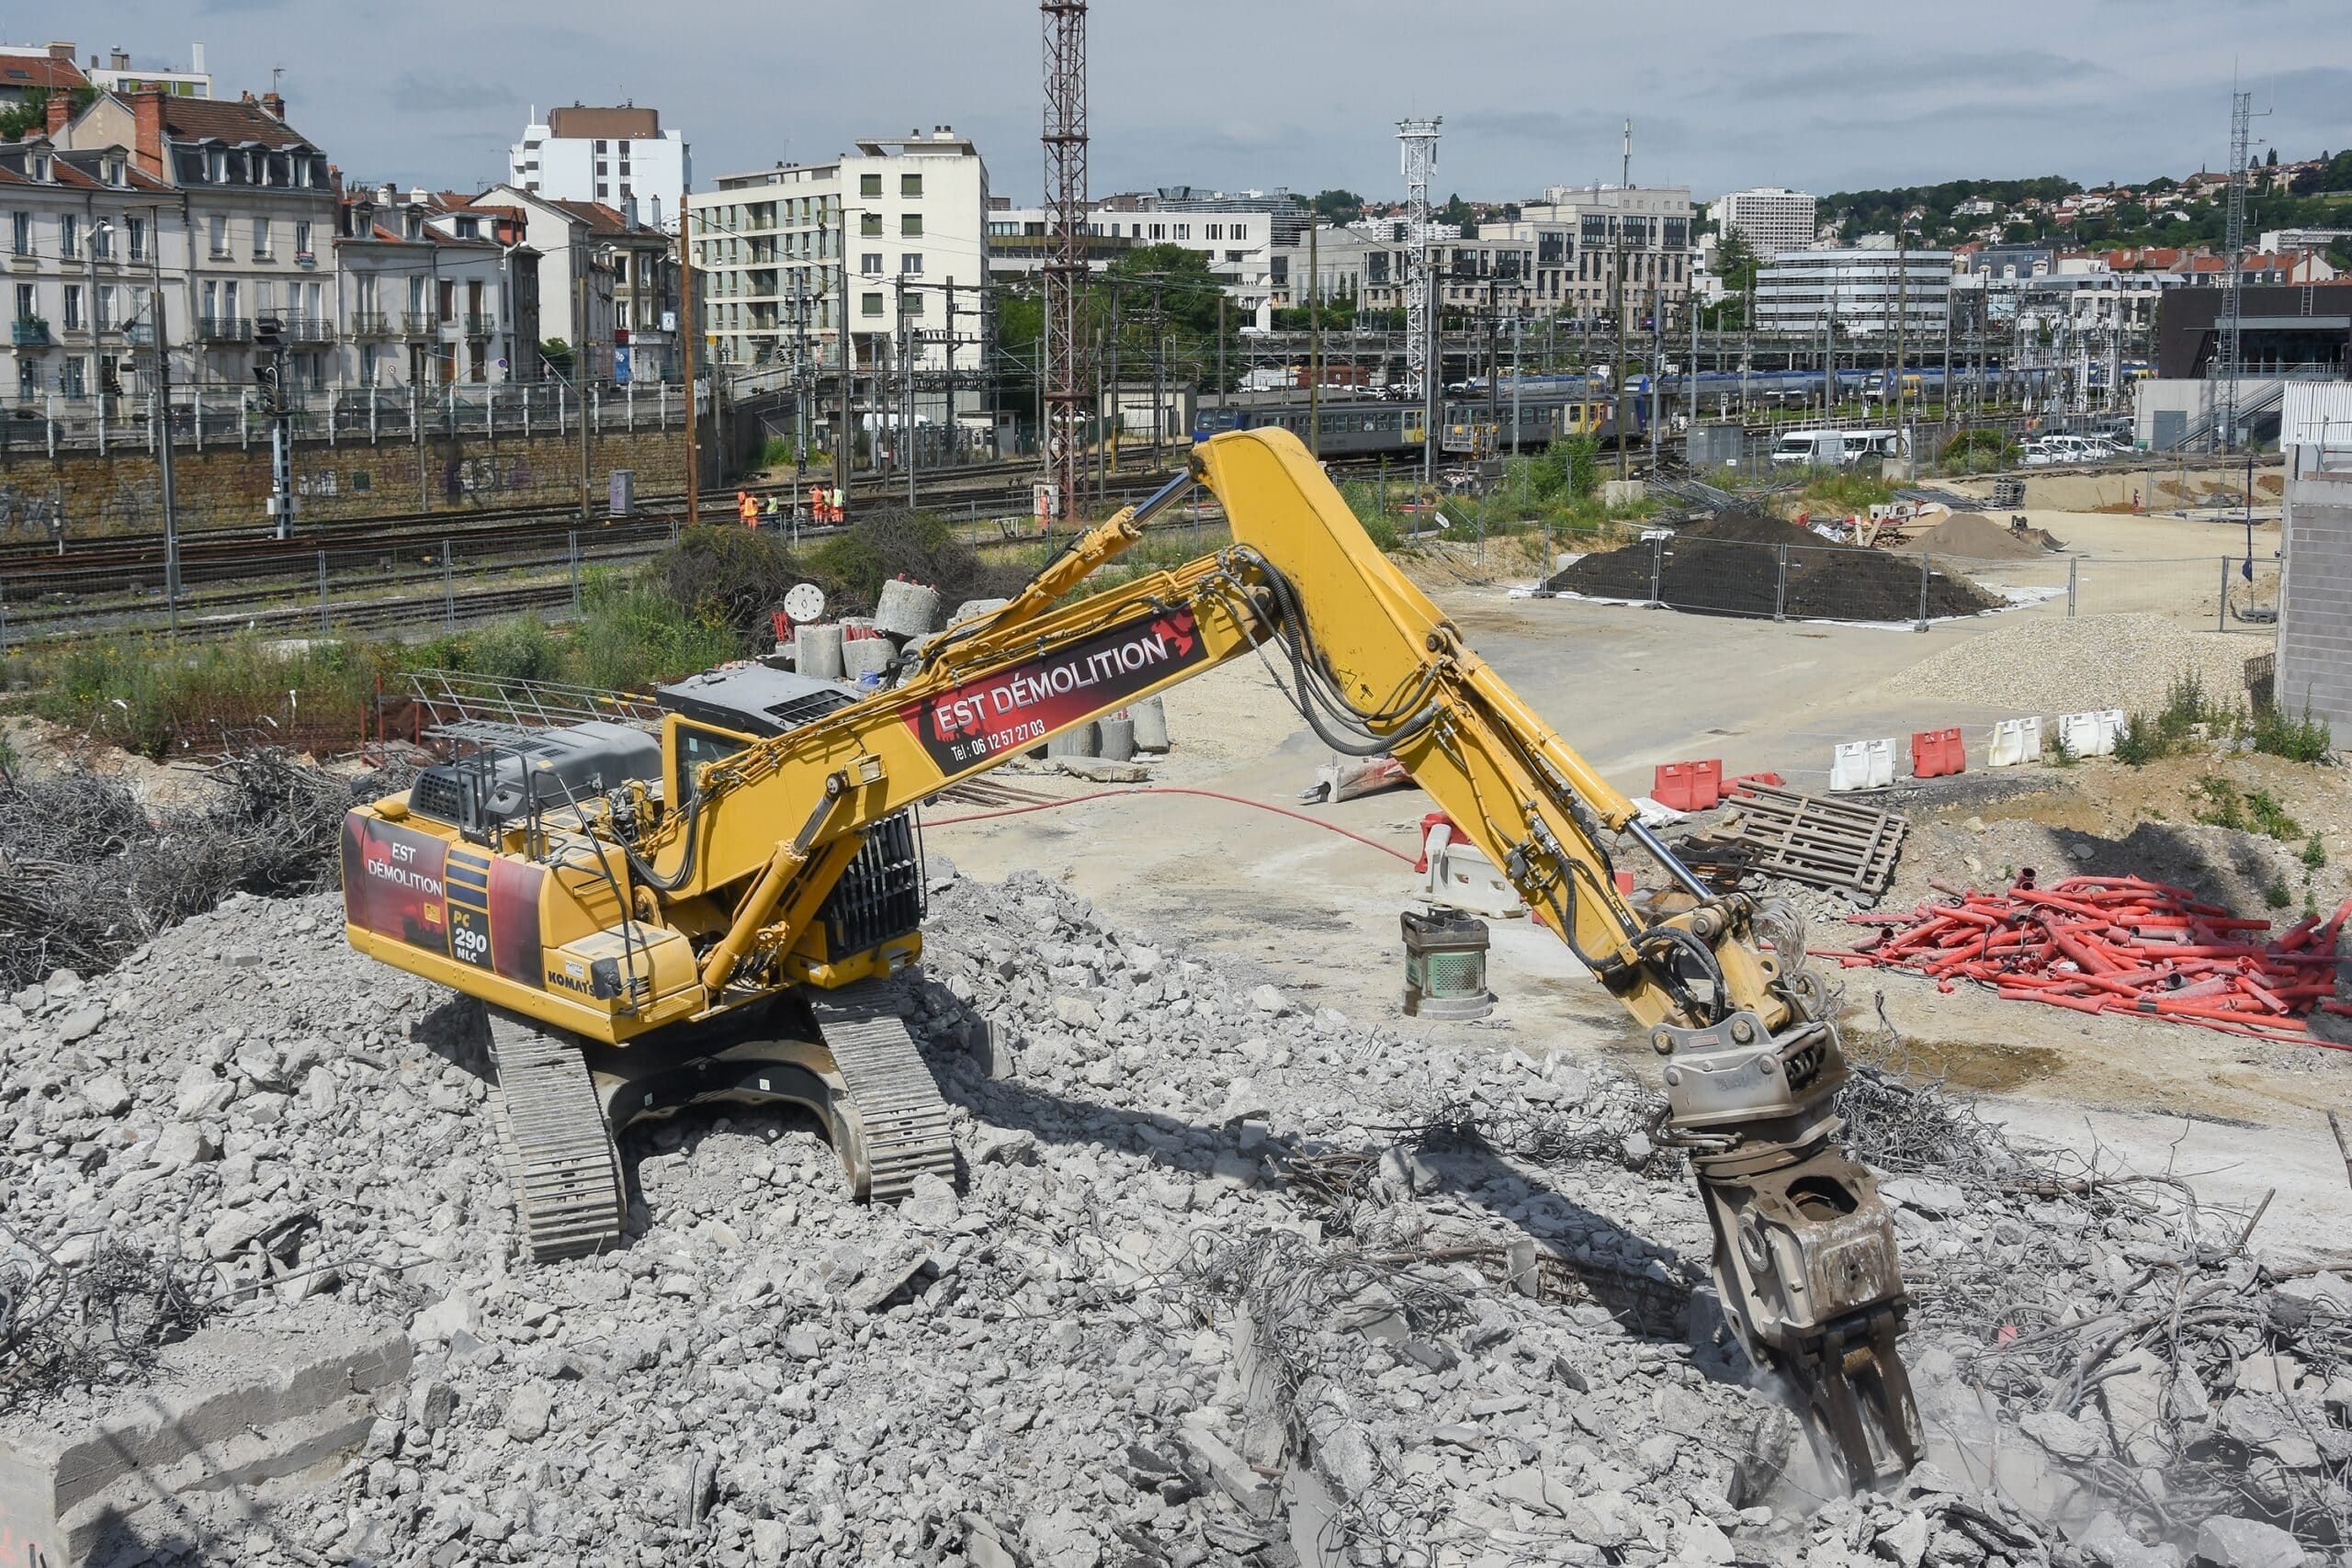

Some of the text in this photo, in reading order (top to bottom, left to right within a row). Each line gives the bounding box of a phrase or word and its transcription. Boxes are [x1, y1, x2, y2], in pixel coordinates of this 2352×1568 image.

[935, 633, 1169, 733] EST DÉMOLITION
[971, 739, 987, 755] 06
[988, 734, 1001, 750] 12
[1000, 728, 1014, 746] 57
[1015, 724, 1029, 741] 27
[1030, 719, 1046, 736] 03
[392, 841, 416, 863] EST
[368, 858, 443, 897] DÉMOLITION
[453, 910, 470, 928] PC
[454, 927, 487, 953] 290
[457, 947, 477, 964] NLC
[548, 970, 596, 998] KOMATS
